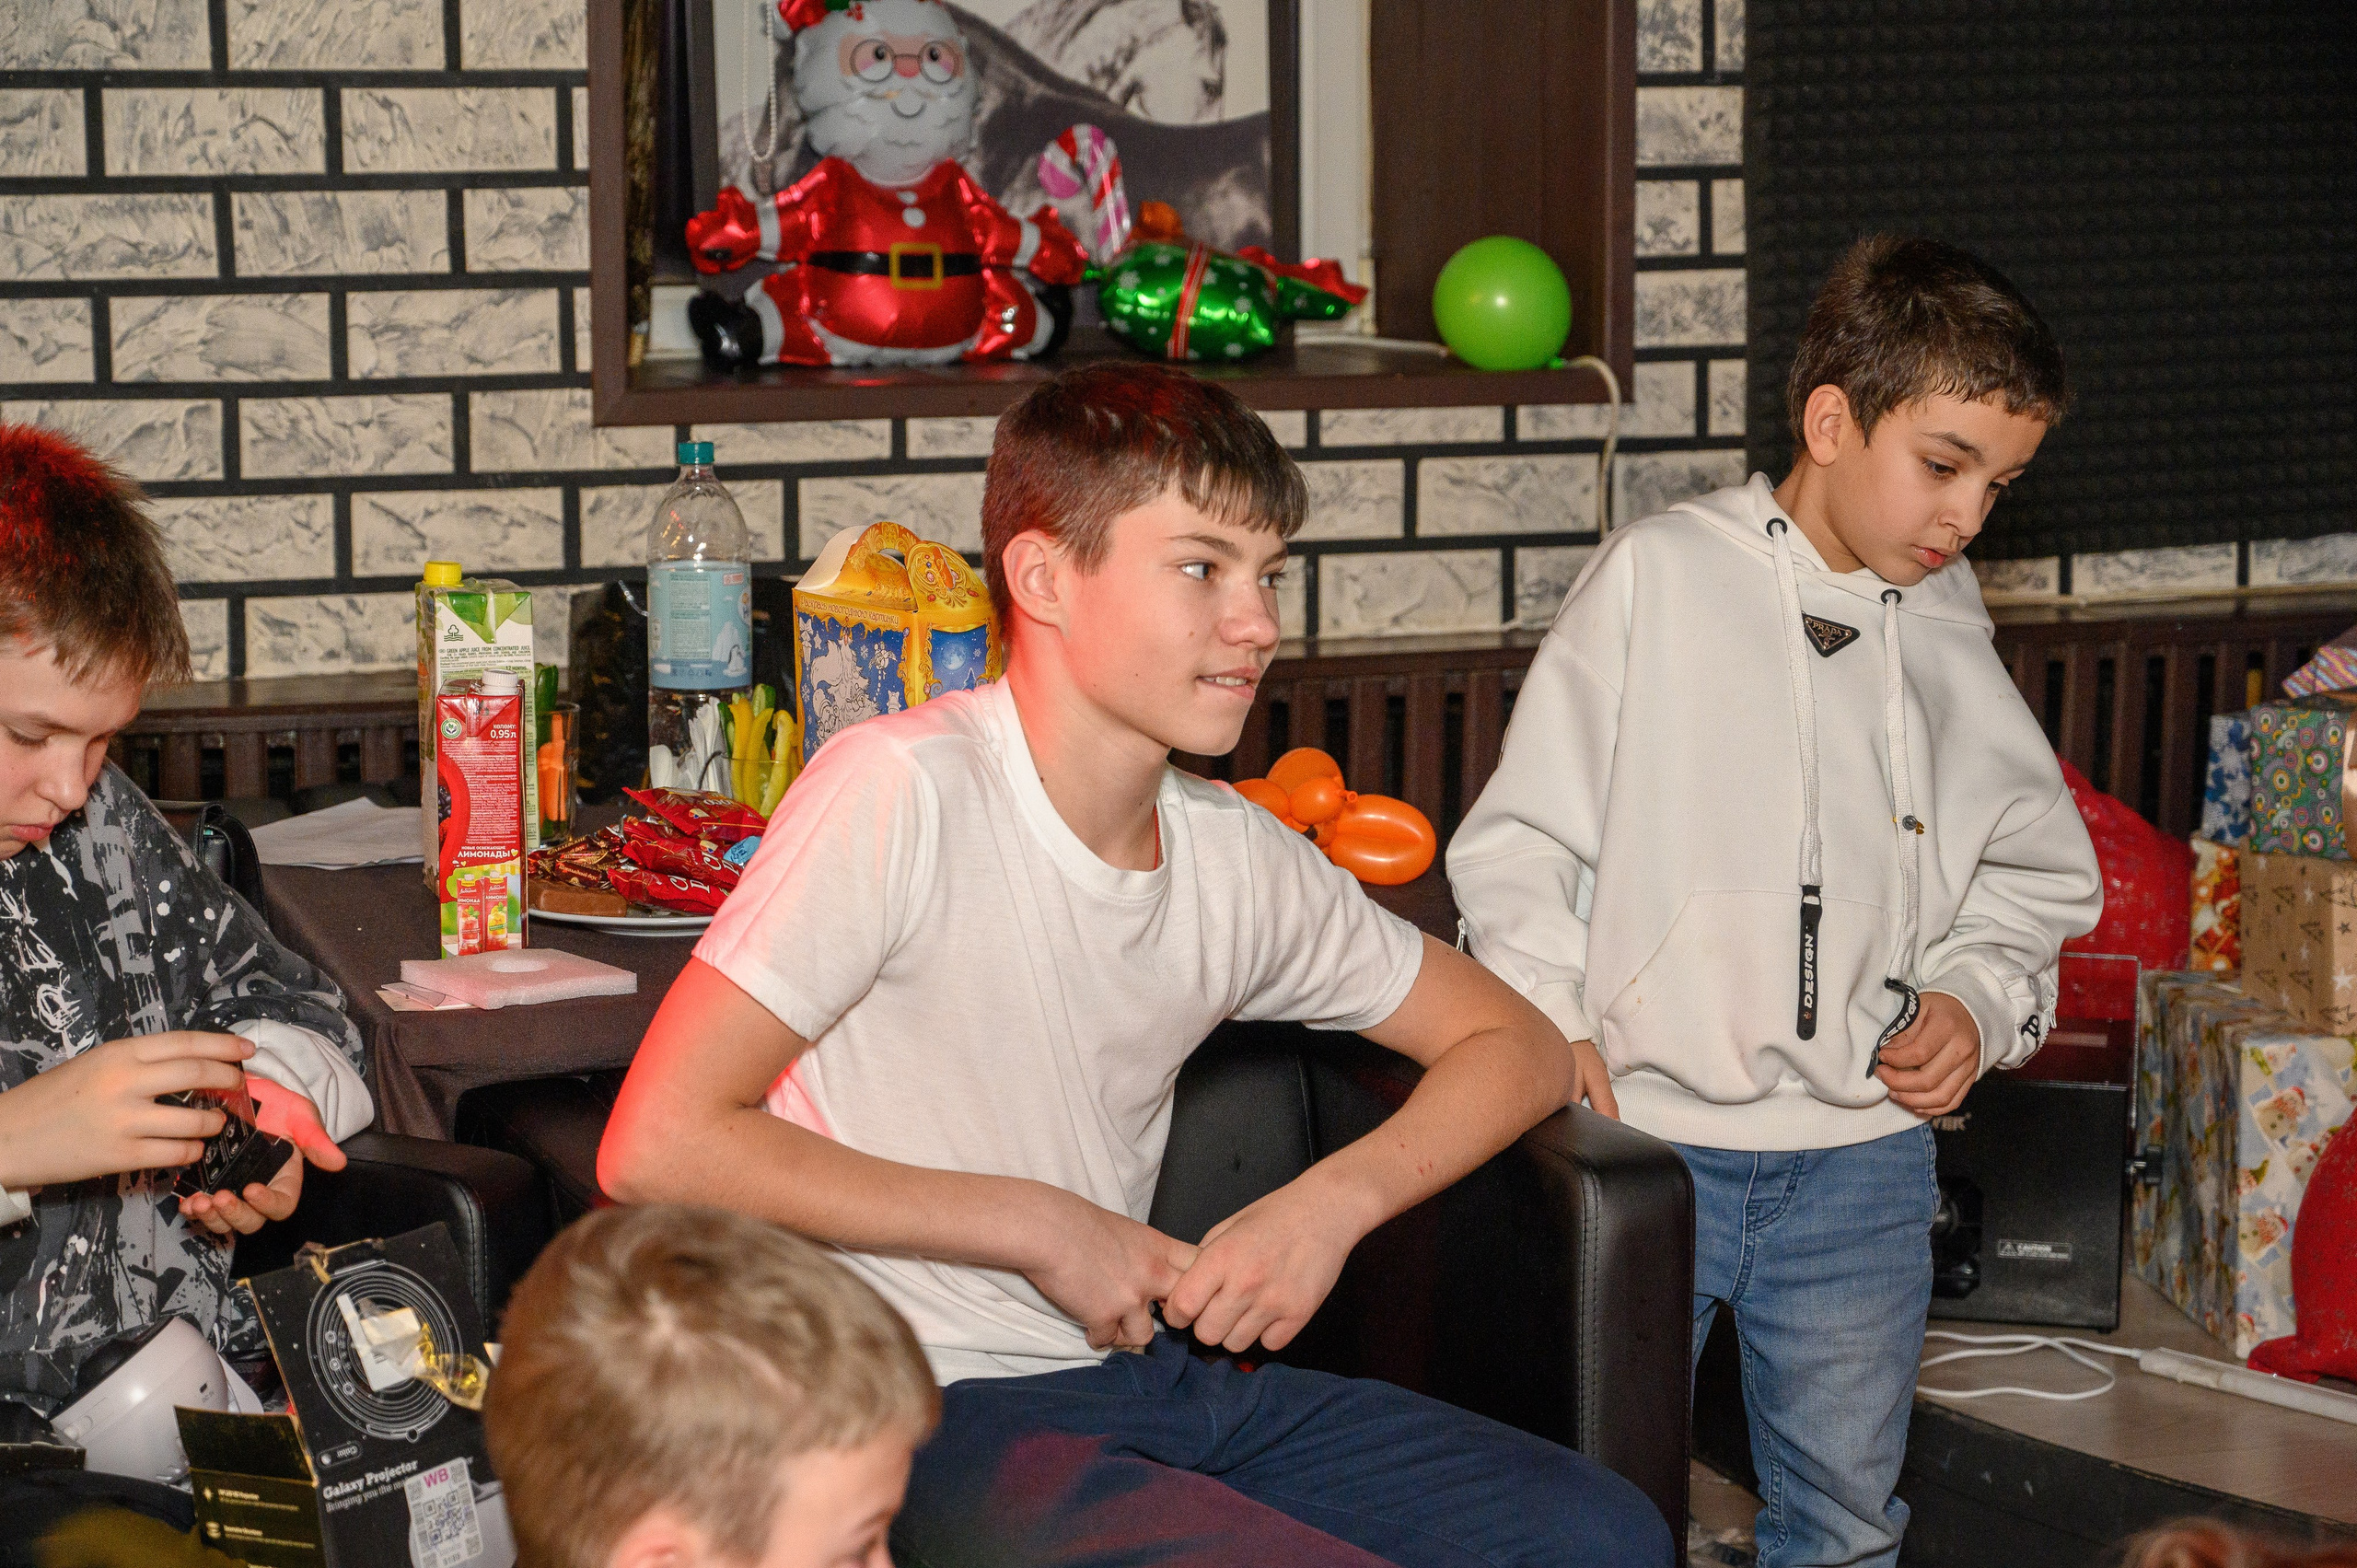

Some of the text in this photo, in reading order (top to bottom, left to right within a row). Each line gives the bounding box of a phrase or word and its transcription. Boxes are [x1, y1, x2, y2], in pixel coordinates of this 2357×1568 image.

[800, 595, 828, 610] Раскрась
[868, 610, 900, 628] картинку
[1812, 621, 1842, 637] PRADA
[490, 729, 510, 739] 0,95
[1804, 934, 1814, 1009] DESIGN
[322, 1477, 365, 1500] Galaxy
[365, 1460, 419, 1486] Projector
[423, 1468, 449, 1488] WB
[325, 1493, 363, 1513] Bringing
[363, 1489, 378, 1503] you
[378, 1484, 392, 1496] the
